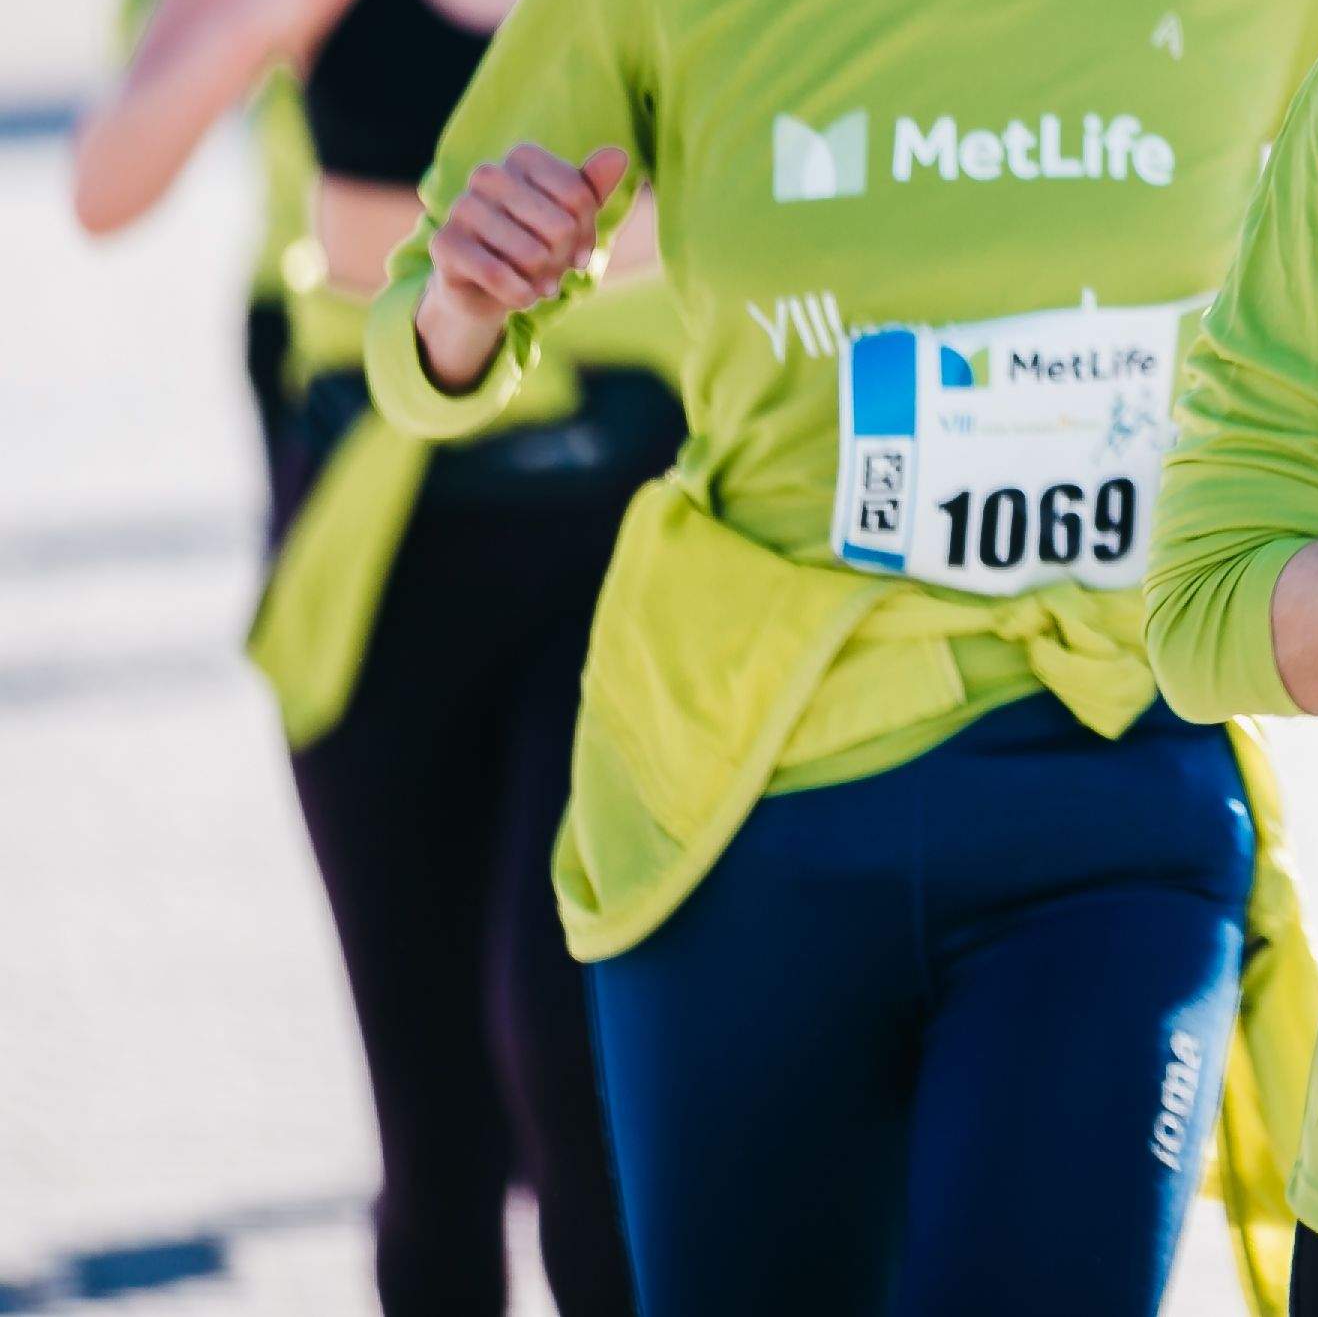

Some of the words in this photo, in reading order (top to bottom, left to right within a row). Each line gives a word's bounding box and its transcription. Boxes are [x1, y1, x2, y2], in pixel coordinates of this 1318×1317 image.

[893, 113, 1174, 185] MetLife
[1009, 349, 1157, 383] MetLife
[938, 477, 1135, 570] 1069
